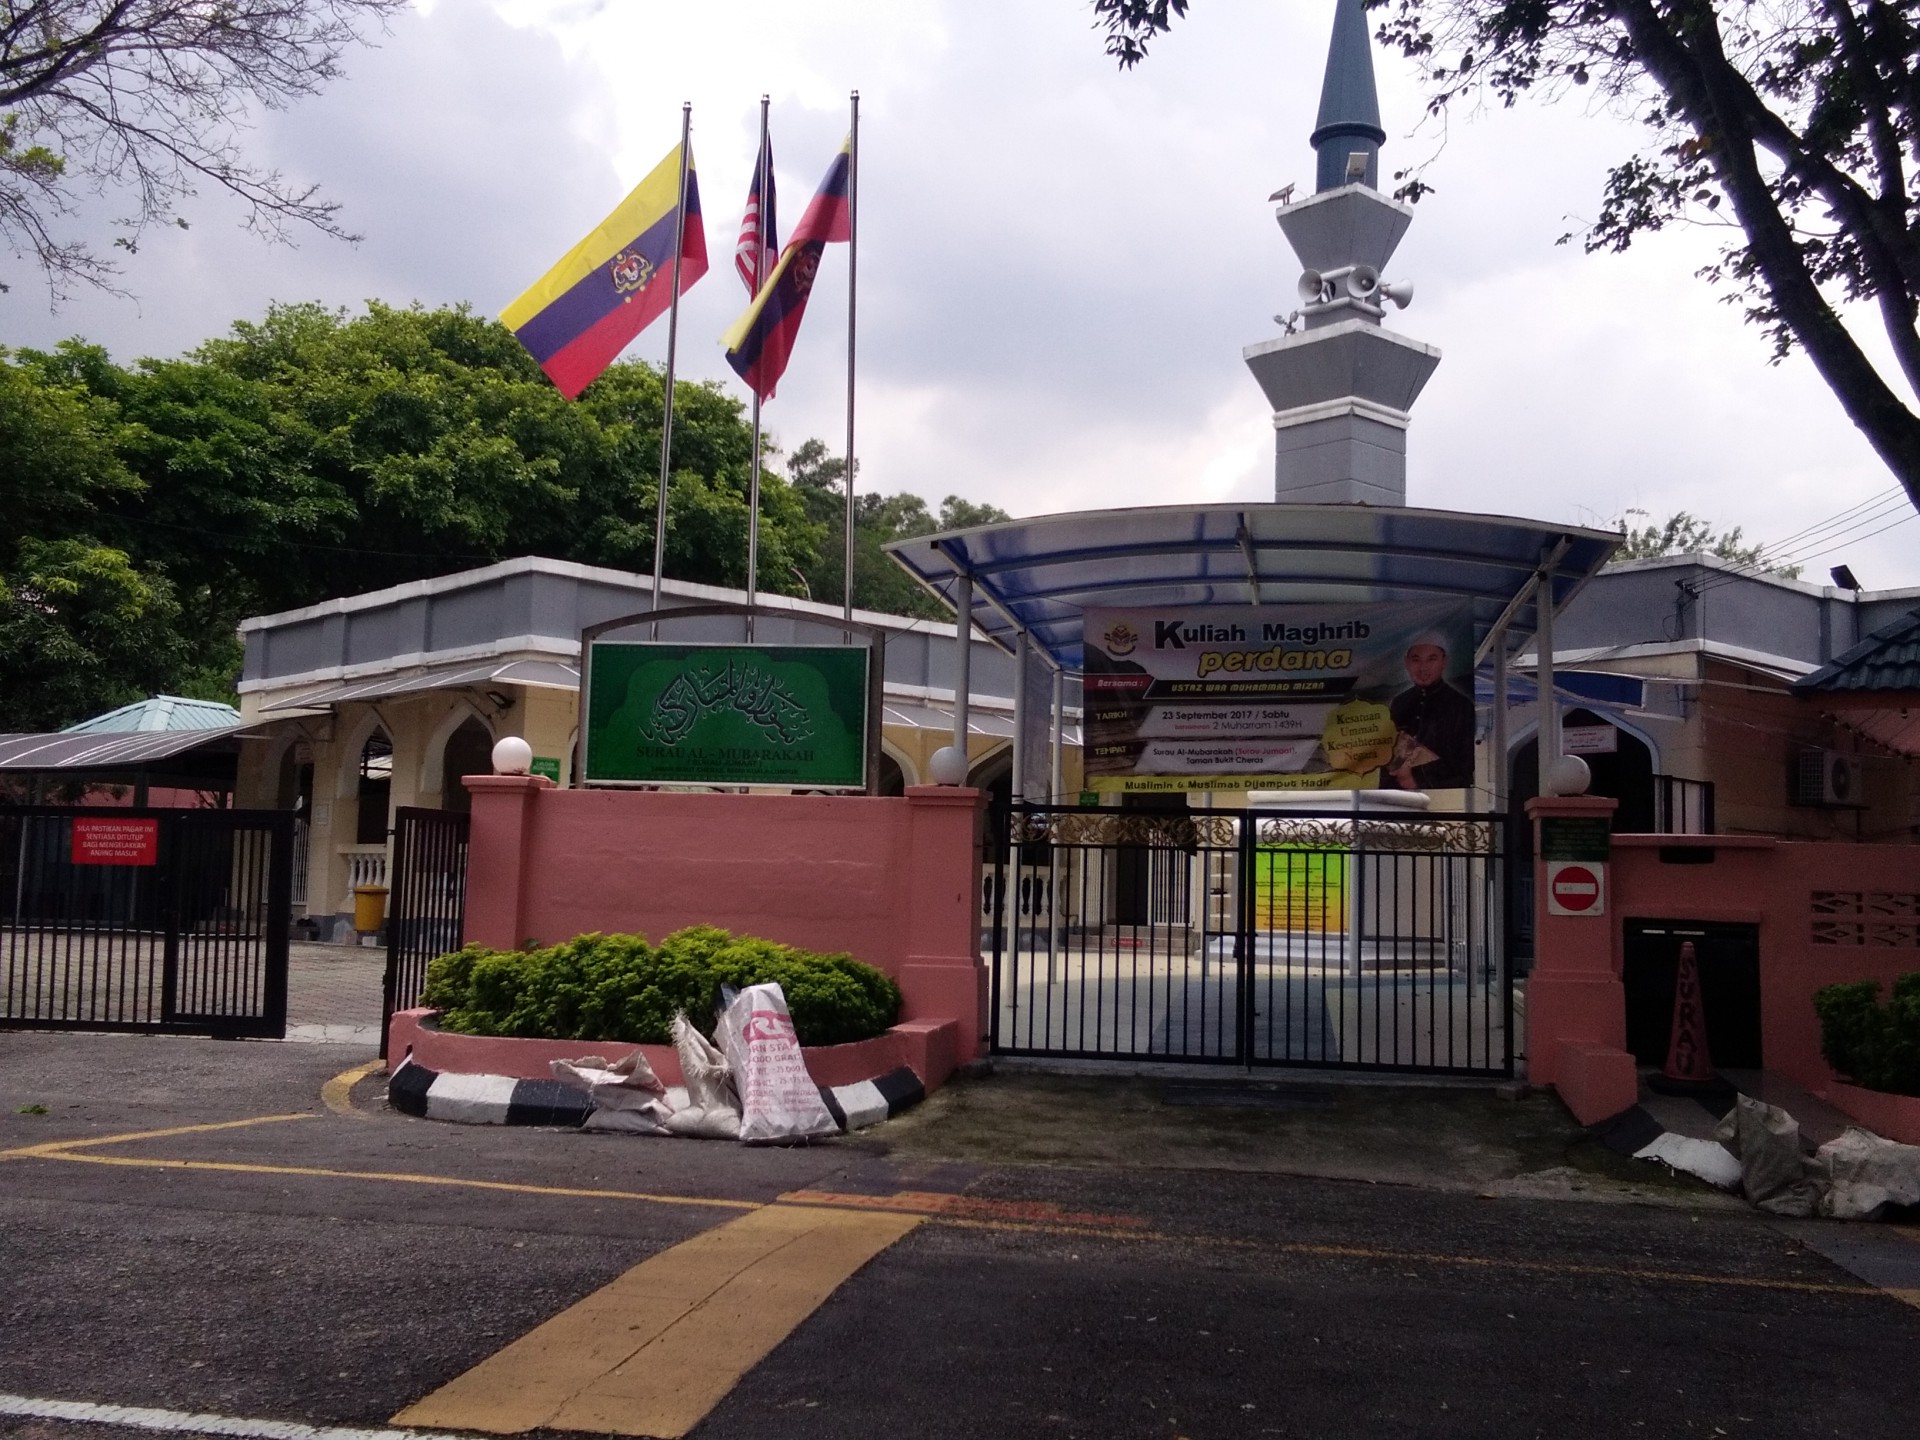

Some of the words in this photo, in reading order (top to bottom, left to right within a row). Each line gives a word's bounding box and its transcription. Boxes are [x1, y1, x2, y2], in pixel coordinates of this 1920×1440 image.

[1155, 621, 1246, 649] Kuliah
[1262, 621, 1370, 645] Maghrib
[1197, 645, 1352, 678] perdana
[1097, 679, 1138, 687] Bersama
[1171, 683, 1203, 692] USTAZ
[1230, 682, 1289, 691] MUHAMMAD
[1096, 710, 1128, 720] TARIKH
[1162, 711, 1174, 720] 23
[1175, 711, 1228, 722] September
[1230, 710, 1253, 719] 2017
[1262, 710, 1290, 719] Sabtu
[1336, 712, 1381, 724] Kesatuan
[1212, 721, 1219, 730] 2
[1221, 720, 1271, 730] Muharram
[1340, 723, 1379, 737] Ummah
[637, 746, 686, 758] SURAU
[1095, 746, 1127, 755] TEMPAT
[1153, 748, 1175, 756] Surau
[1177, 747, 1233, 756] Al-Mubarakah
[1215, 756, 1234, 764] Bukit
[1235, 756, 1264, 764] Cheras
[1125, 781, 1173, 790] Muslimin
[1301, 778, 1331, 788] Hadir
[90, 849, 114, 857] ANJING
[1676, 957, 1698, 1073] SURAU
